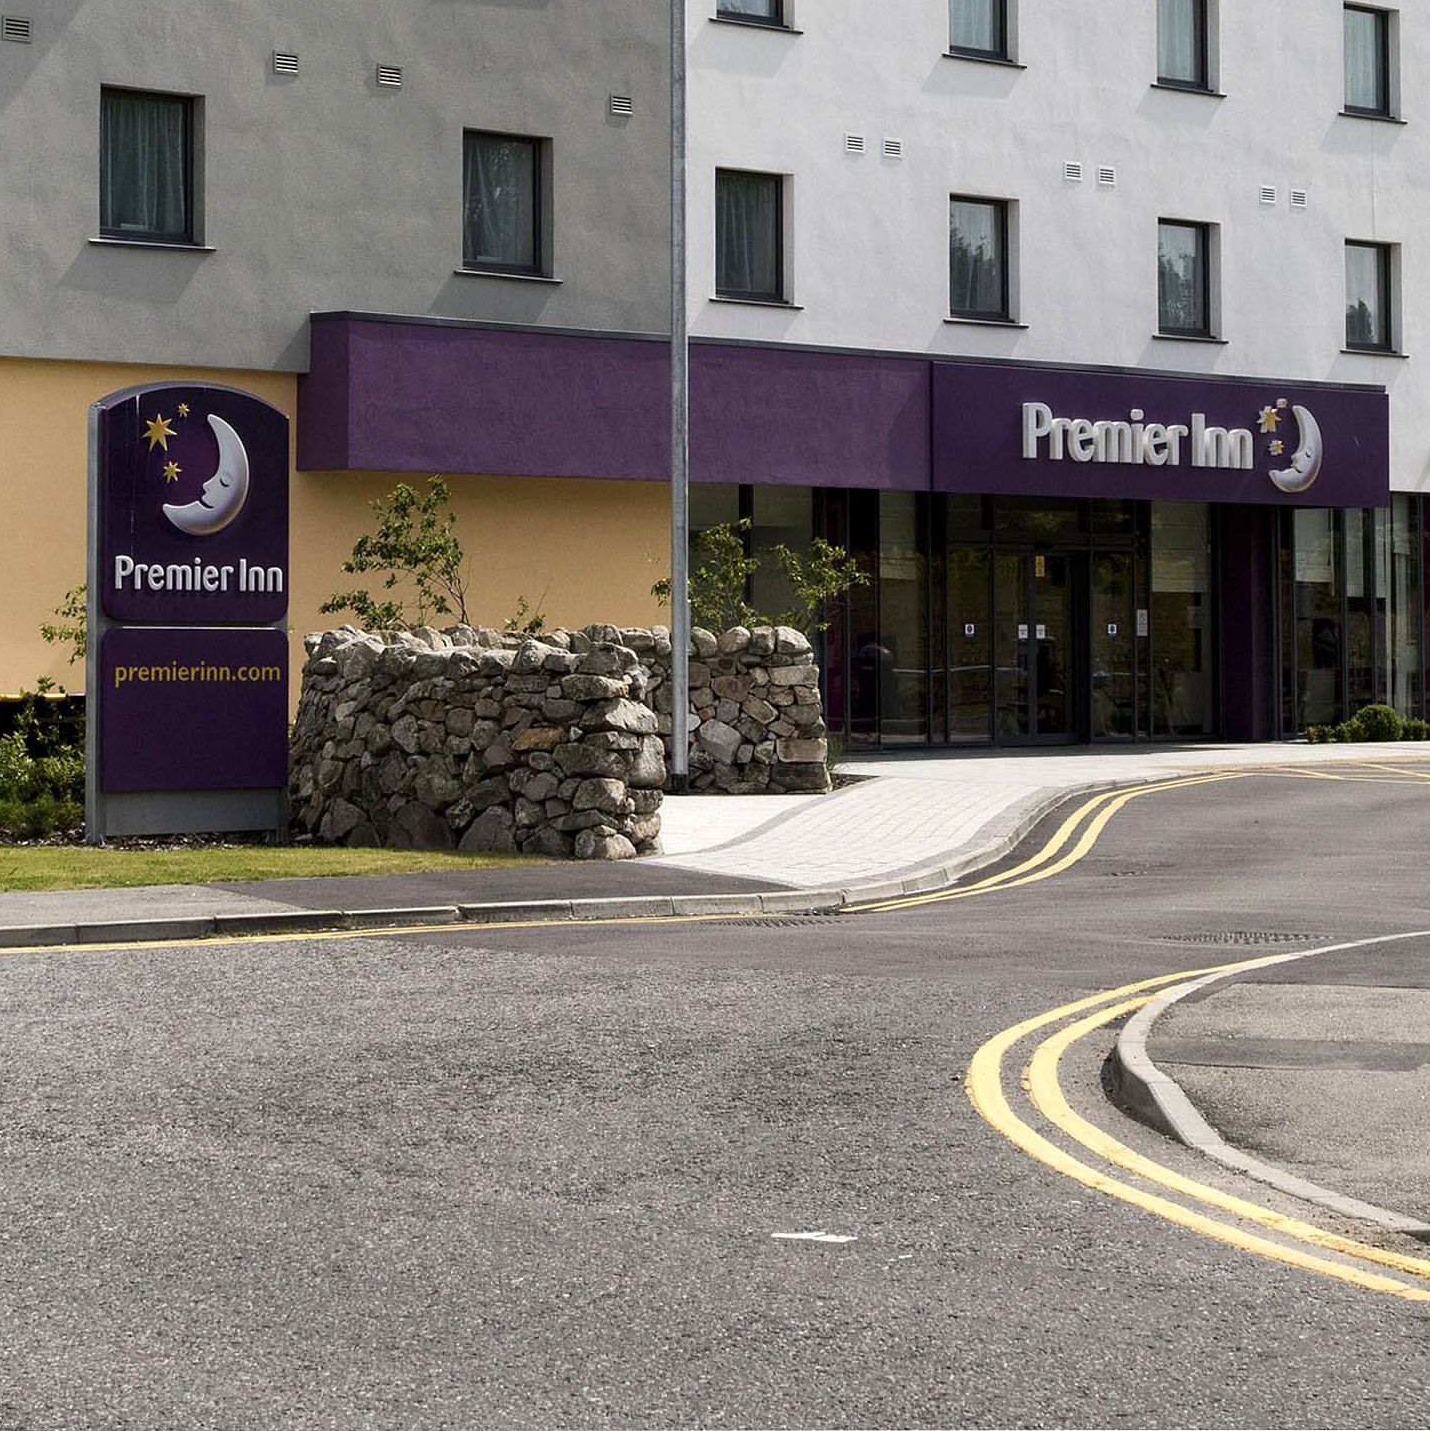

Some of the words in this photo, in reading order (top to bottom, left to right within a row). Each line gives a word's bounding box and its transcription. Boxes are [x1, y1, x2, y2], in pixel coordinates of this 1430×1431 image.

[1021, 401, 1188, 466] Premier
[1191, 412, 1254, 469] Inn
[114, 555, 234, 593] Premier
[238, 558, 284, 594] Inn
[114, 660, 281, 688] premierinn.com
